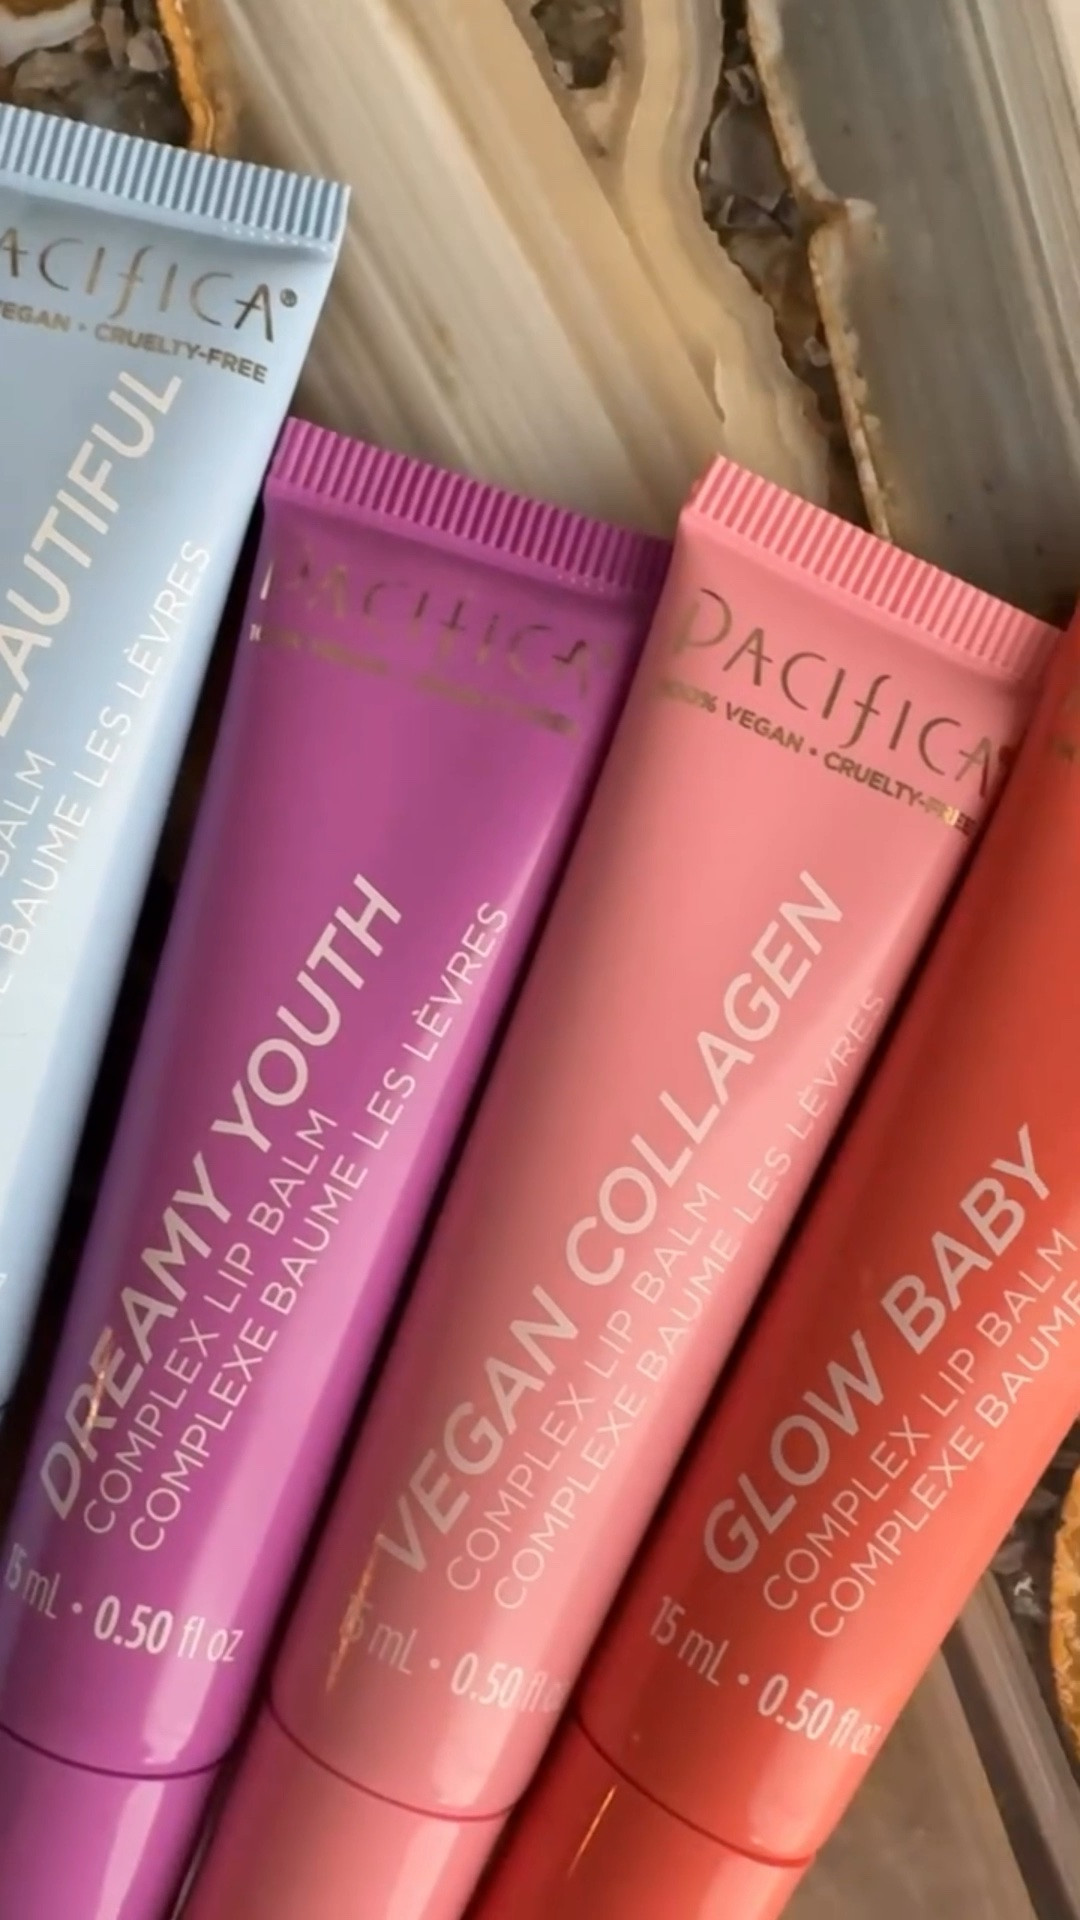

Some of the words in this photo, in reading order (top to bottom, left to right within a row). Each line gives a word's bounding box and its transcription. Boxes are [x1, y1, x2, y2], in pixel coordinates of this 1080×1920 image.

[0, 299, 71, 332] EGAN
[94, 321, 268, 384] CRUELTY-FREE
[0, 794, 91, 955] BAUME
[73, 706, 132, 788] LES
[117, 540, 210, 700] LÈVRES
[725, 701, 805, 753] VEGAN
[824, 751, 977, 837] CRUELTY-FREE
[40, 1151, 231, 1519] DREAMY
[210, 873, 401, 1154] YOUTH
[84, 1319, 219, 1534] COMPLEX
[204, 1242, 254, 1313] LIP
[247, 1108, 338, 1236] BALM
[130, 1318, 278, 1551] COMPLEXE
[260, 1155, 368, 1316] BAUME
[352, 1067, 415, 1150] LES
[402, 902, 508, 1061] LÈVRES
[377, 1285, 579, 1573] VEGAN
[566, 870, 843, 1285] COLLAGEN
[447, 1383, 597, 1591] COMPLEX
[585, 1309, 634, 1379] LIP
[631, 1181, 721, 1304] BALM
[494, 1384, 648, 1609] COMPLEXE
[636, 1229, 742, 1382] BAUME
[734, 1146, 792, 1225] LES
[786, 988, 885, 1140] LÈVRES
[703, 1329, 884, 1573] GLOW
[880, 1122, 1050, 1355] BABY
[22, 1569, 61, 1619] mL
[94, 1595, 173, 1654] 0.50
[178, 1616, 205, 1658] fl
[207, 1629, 243, 1662] oz
[763, 1414, 931, 1611] COMPLEX
[921, 1348, 976, 1417] LIP
[976, 1228, 1079, 1348] BALM
[810, 1425, 984, 1638] COMPLEXE
[975, 1280, 1080, 1428] BAUME
[368, 1621, 418, 1675] mL
[450, 1652, 524, 1709] 0.50
[650, 1595, 686, 1645] 15
[679, 1629, 729, 1686] mL
[757, 1673, 834, 1740] 0.50
[829, 1707, 860, 1749] fl
